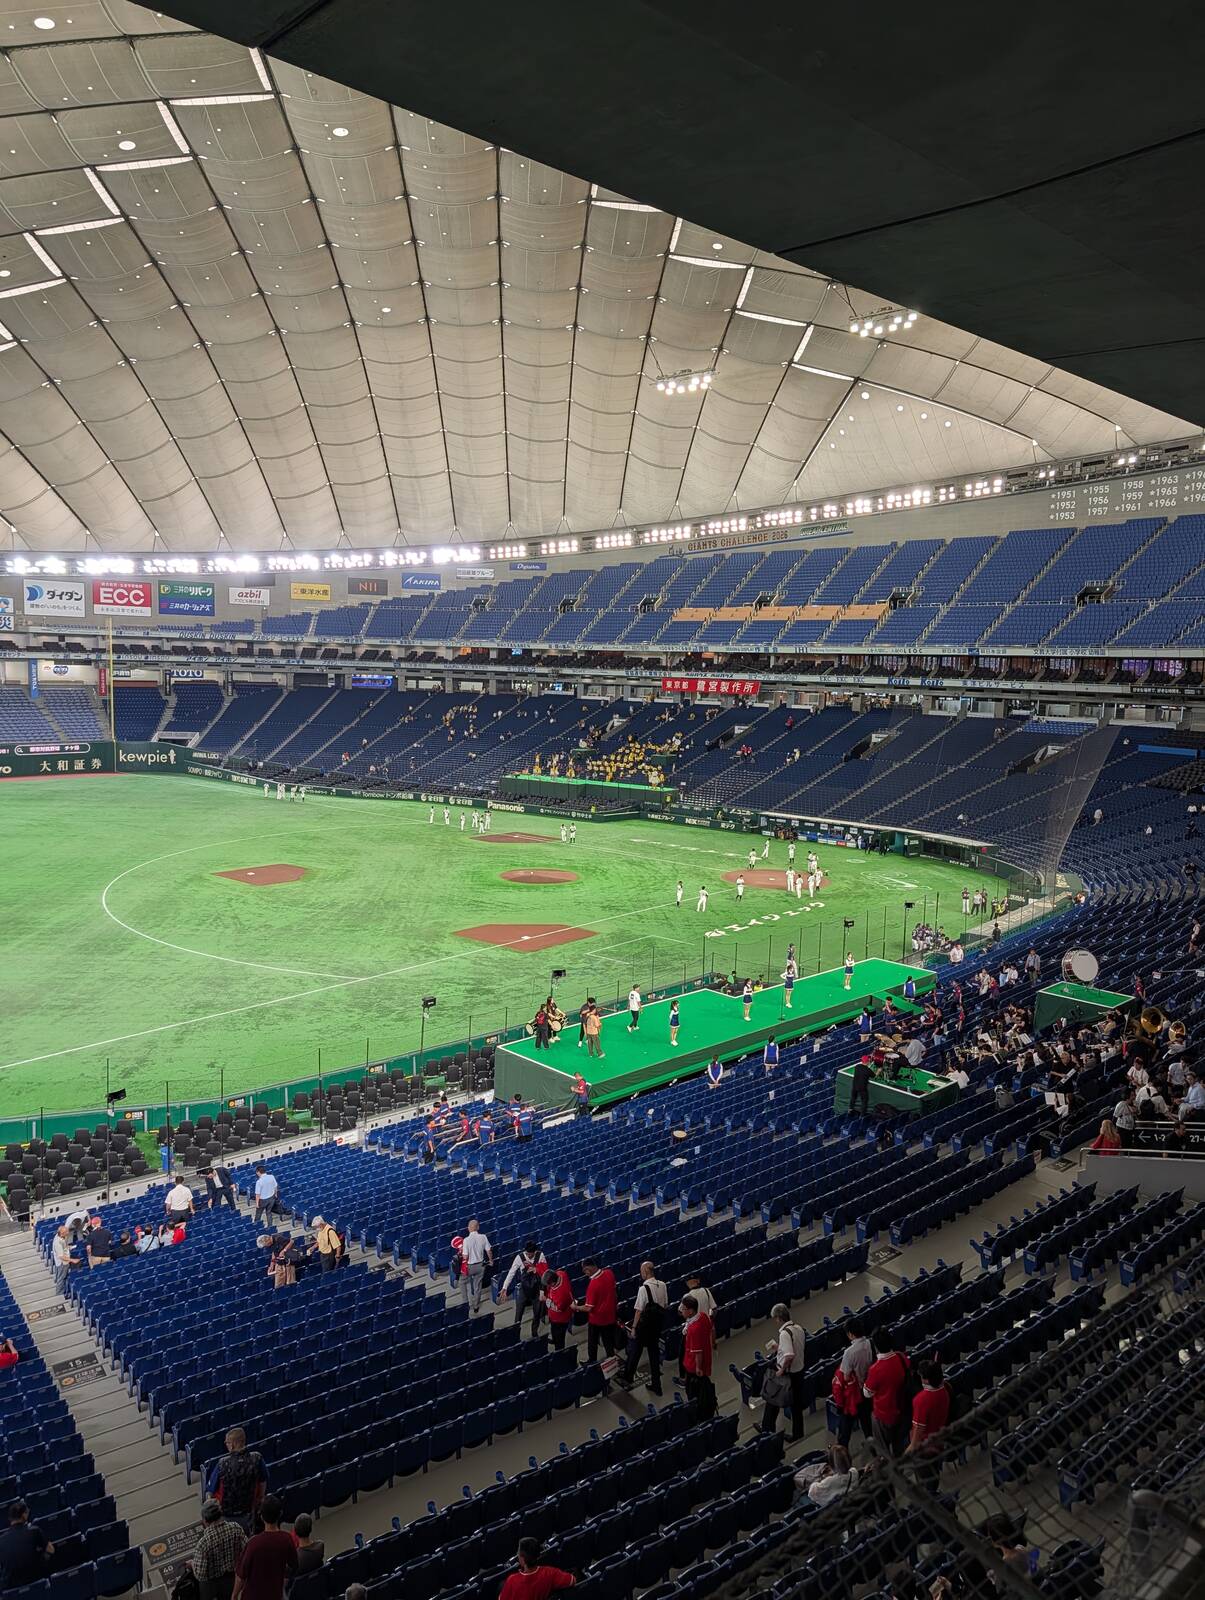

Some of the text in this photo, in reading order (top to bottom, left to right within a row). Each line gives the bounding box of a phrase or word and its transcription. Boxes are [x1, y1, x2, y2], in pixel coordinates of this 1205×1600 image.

[1057, 490, 1076, 499] 1951
[1089, 485, 1110, 494] 1955
[1123, 480, 1144, 490] 1958
[1157, 475, 1179, 485] 1963
[1056, 481, 1205, 510] 1952 1956 1959 1965 196
[1055, 511, 1075, 520] 1953
[1088, 507, 1108, 516] 1957
[1121, 502, 1141, 512] 1961
[1155, 498, 1177, 508] 1966
[687, 539, 717, 551] GIANTS
[720, 532, 769, 547] CHALLENGE
[46, 589, 83, 601] ダイダン
[100, 587, 145, 605] ECC
[174, 585, 213, 597] 三井のリパーク
[237, 590, 262, 599] azbil
[171, 669, 203, 677] TOTO
[665, 681, 689, 689] 東京都
[119, 749, 168, 765] kewpie
[40, 758, 102, 772] 大和証券
[487, 800, 525, 812] Panasonic
